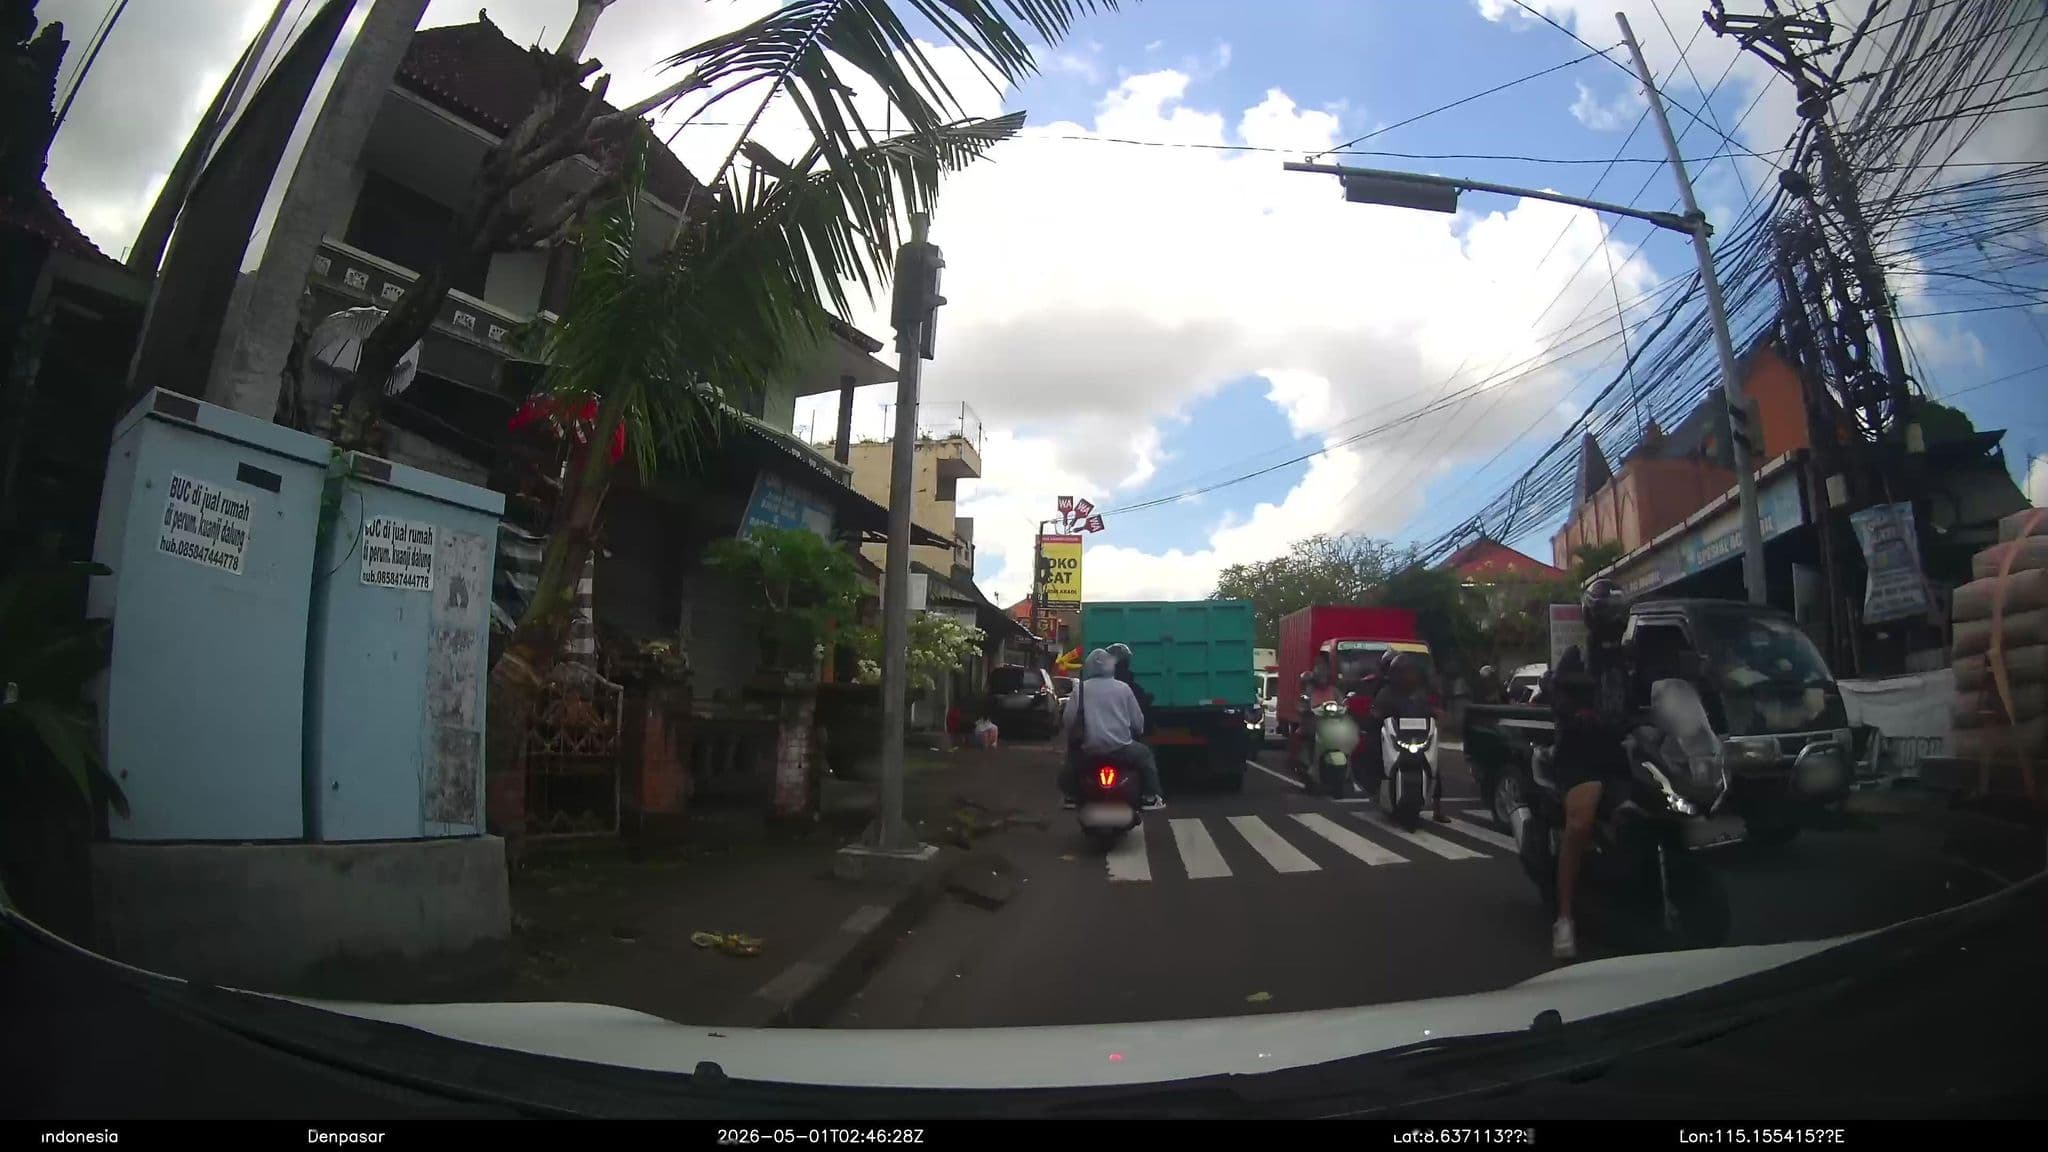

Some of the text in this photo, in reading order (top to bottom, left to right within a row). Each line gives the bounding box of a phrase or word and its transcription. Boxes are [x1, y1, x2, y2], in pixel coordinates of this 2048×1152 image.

[170, 476, 250, 521] BUC di jual rumah
[164, 502, 174, 526] di
[220, 520, 245, 553] dalung
[382, 519, 392, 540] di
[391, 521, 408, 544] jual
[408, 527, 433, 545] rumah
[159, 535, 240, 571] hub.085847444778
[411, 547, 432, 574] dalung
[1049, 558, 1078, 569] OKO
